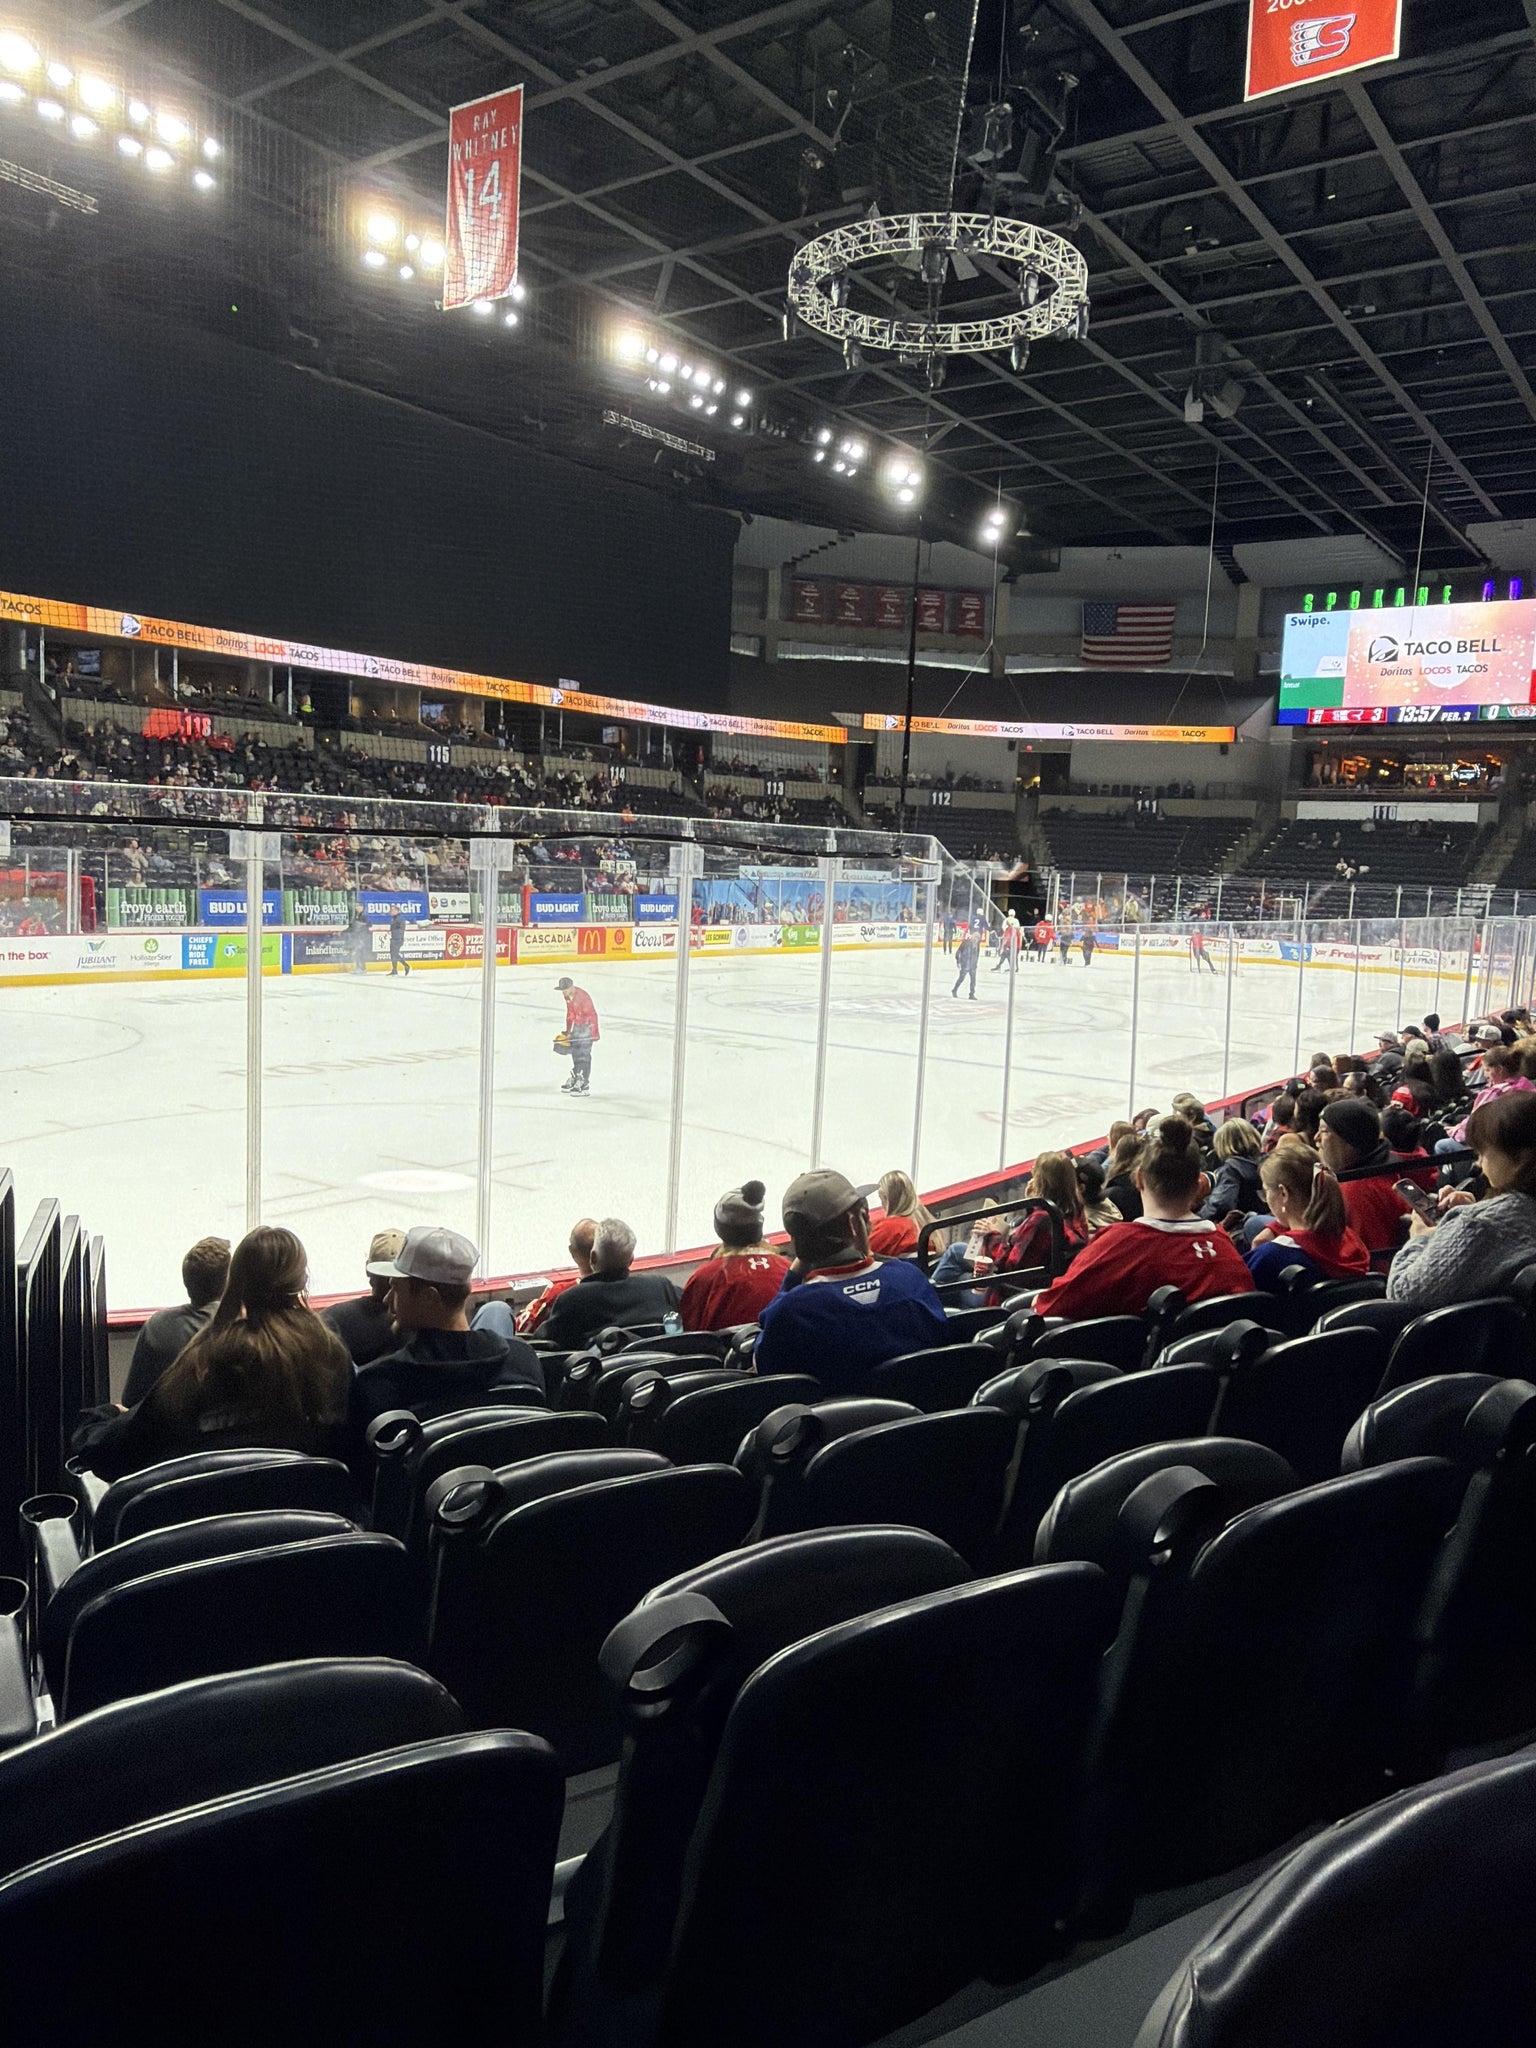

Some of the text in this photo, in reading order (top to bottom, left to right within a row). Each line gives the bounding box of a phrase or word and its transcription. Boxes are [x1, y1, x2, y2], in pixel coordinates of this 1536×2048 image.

[473, 109, 498, 132] RAY
[452, 123, 519, 162] WHITNEY
[464, 159, 503, 226] 14
[842, 279, 881, 295] CCM
[0, 598, 42, 615] TACOS
[1303, 585, 1453, 613] SPOKANE
[1290, 616, 1331, 628] Swipe.
[143, 624, 319, 661] TACO BELL Doritos LOCOS TACOS
[1404, 638, 1501, 657] TACO BELL
[1380, 664, 1489, 677] Doritos LOCOS TACOS
[380, 664, 400, 675] TACO
[401, 668, 421, 678] BELL
[486, 681, 510, 694] TACOS
[565, 695, 582, 706] TACO
[583, 698, 599, 709] BELL
[649, 709, 667, 719] TACOS
[1371, 708, 1383, 721] 3
[1399, 706, 1471, 723] 13:57 PER. 3
[1487, 705, 1499, 720] 0
[709, 718, 726, 727] TACO
[728, 720, 744, 730] BELL
[802, 726, 824, 736] TACOS
[921, 721, 940, 729] BELL
[947, 722, 970, 731] Doritos
[974, 724, 997, 732] LOCOS
[1001, 725, 1024, 734] TACOS
[1076, 728, 1095, 736] TACO
[1096, 728, 1114, 736] BELL
[1124, 728, 1149, 737] Doritos
[1181, 730, 1206, 738] TACOS
[429, 744, 450, 764] 115
[610, 766, 626, 782] 114
[766, 781, 784, 796] 113
[931, 791, 951, 806] 112
[1136, 799, 1158, 814] 111
[120, 900, 187, 922] froyo earth
[209, 902, 236, 914] BUD
[295, 902, 348, 922] froyo earth
[368, 903, 390, 914] BUD
[502, 903, 522, 914] earth
[537, 902, 580, 914] BUD LIGHT
[592, 902, 610, 920] froyo
[610, 903, 628, 913] earth
[641, 903, 675, 913] BUD LIGHT
[188, 936, 214, 944] CHIEFS
[523, 933, 573, 944] CASCADIA
[635, 930, 662, 948] Coors
[8, 951, 25, 961] the
[28, 950, 49, 961] box
[77, 956, 117, 969] JUBILANT
[188, 951, 206, 959] RIDE
[188, 958, 209, 967] FREE!
